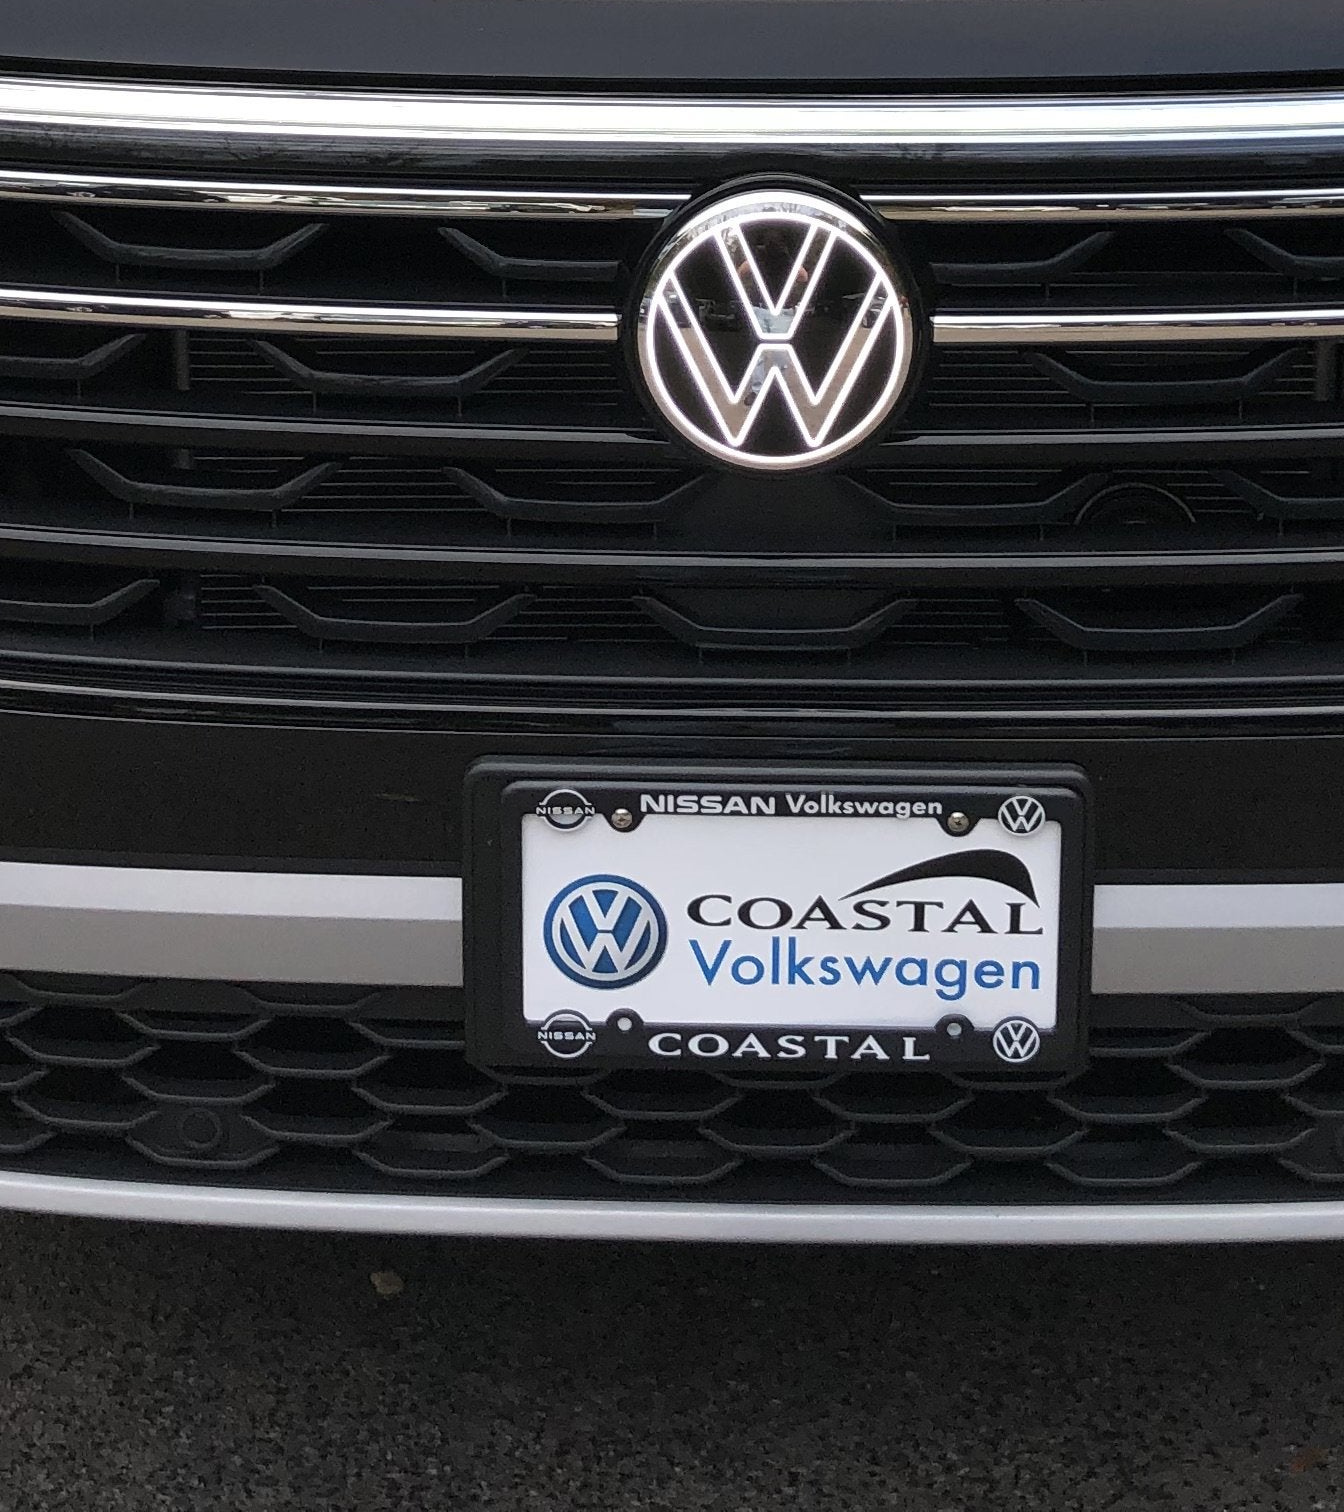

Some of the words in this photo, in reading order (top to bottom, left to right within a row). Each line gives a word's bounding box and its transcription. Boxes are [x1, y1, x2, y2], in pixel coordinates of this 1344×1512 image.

[536, 806, 596, 815] NISSAN
[640, 794, 776, 815] NISSAN
[785, 793, 944, 819] Volkswagen
[687, 895, 1044, 935] COASTAL
[688, 936, 1041, 1001] Volkswagen
[537, 1031, 597, 1041] NISSAN
[648, 1032, 931, 1060] COASTAL
